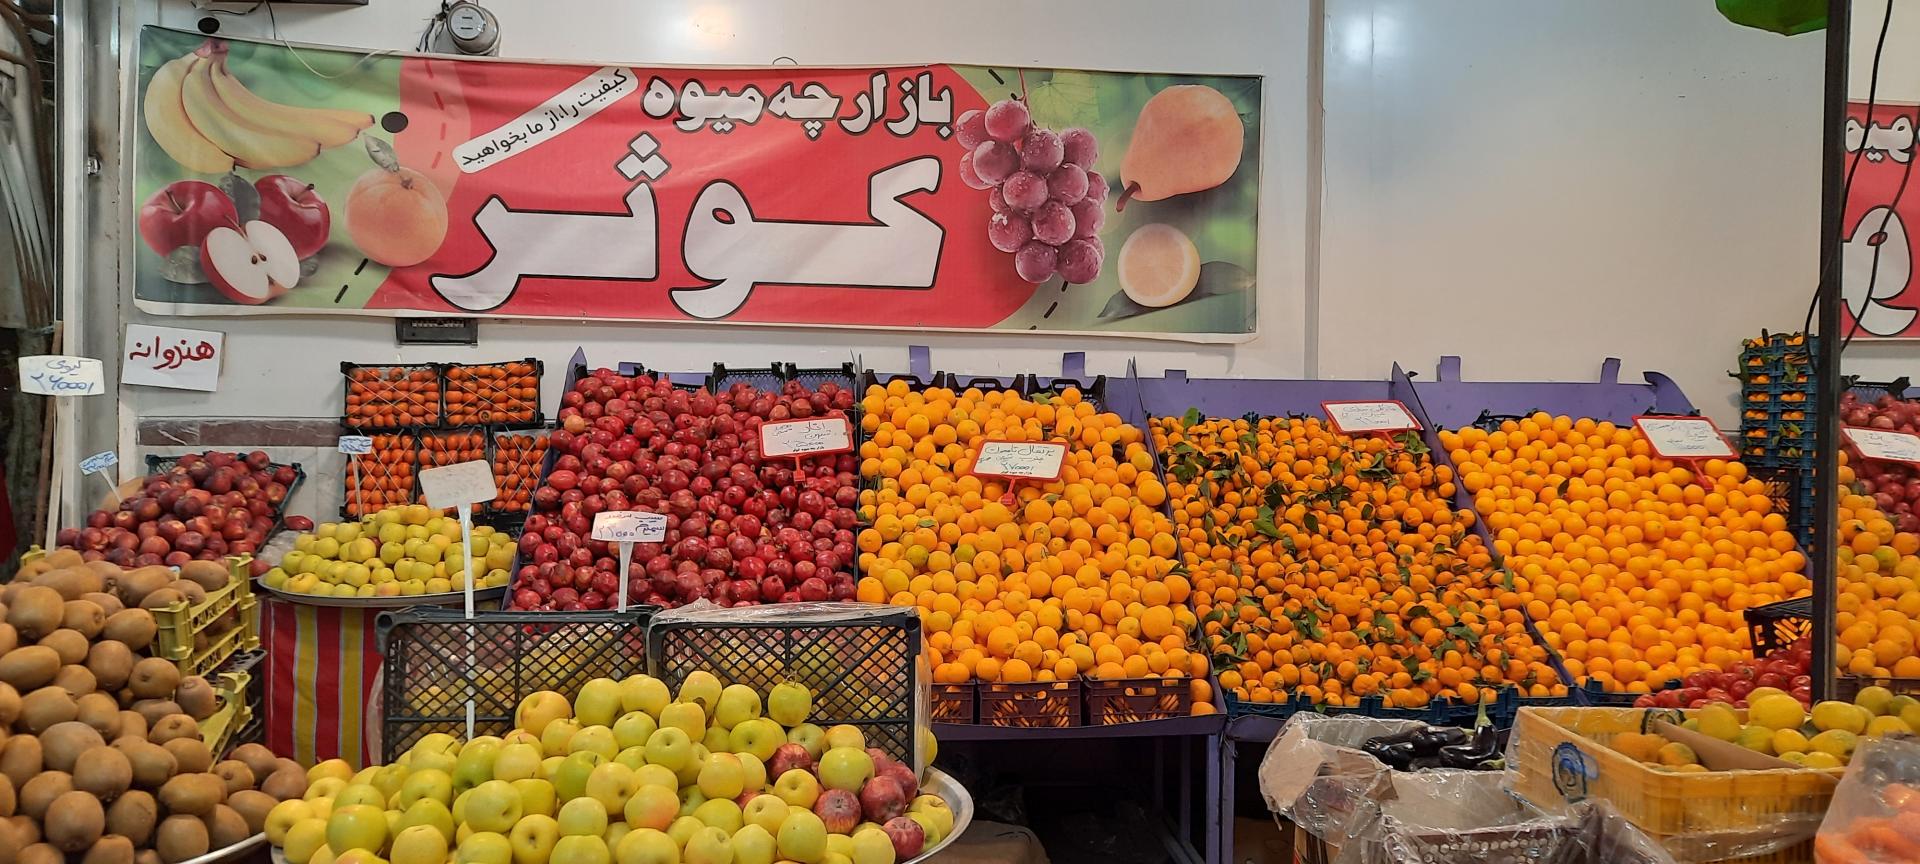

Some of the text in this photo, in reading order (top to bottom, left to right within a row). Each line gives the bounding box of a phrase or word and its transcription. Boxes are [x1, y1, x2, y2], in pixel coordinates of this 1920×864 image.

[577, 68, 628, 107] کیفیت
[640, 73, 765, 135] میوه
[526, 122, 544, 134] ما
[461, 131, 528, 166] بخواهید
[429, 131, 946, 320] کوثر
